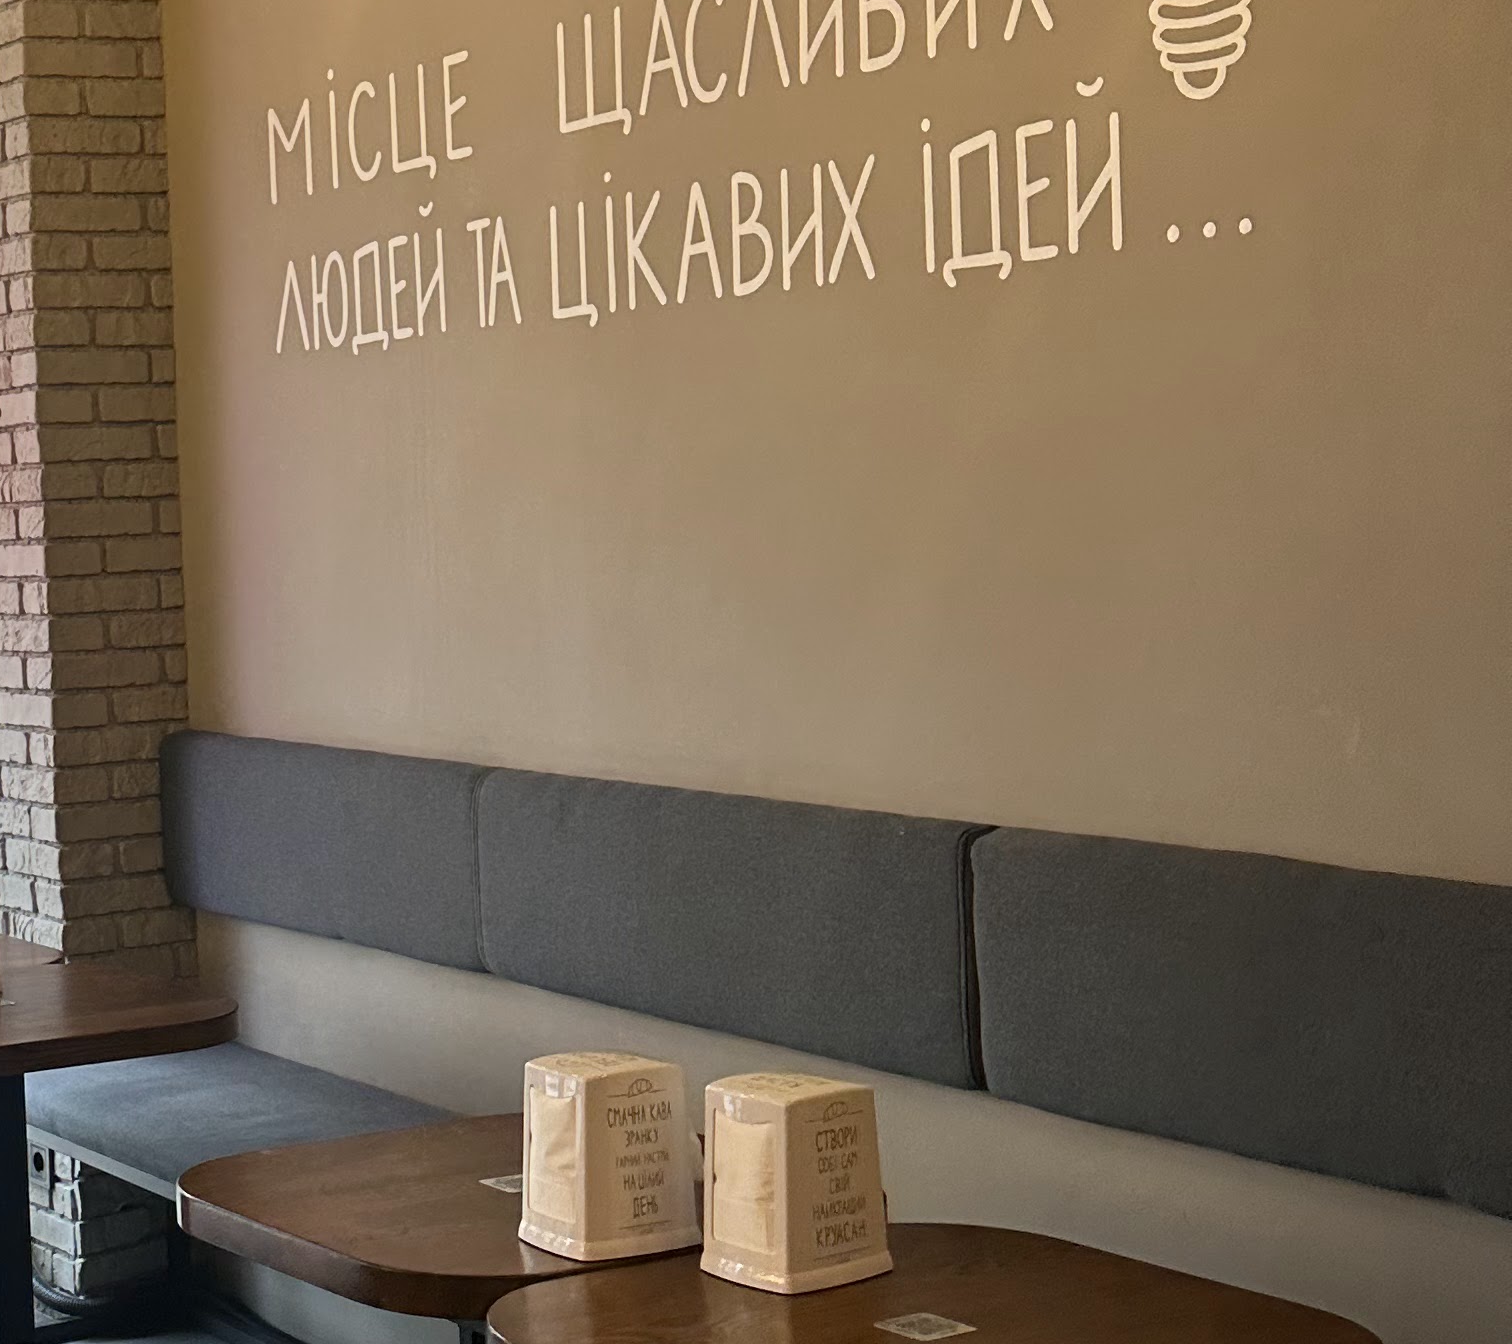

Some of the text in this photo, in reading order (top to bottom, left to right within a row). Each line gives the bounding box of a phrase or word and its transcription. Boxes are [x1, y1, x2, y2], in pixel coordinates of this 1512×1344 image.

[276, 200, 447, 355] ЛЮДЕЙ
[466, 214, 522, 329] ТА
[607, 1100, 672, 1128] СМАЧНА КАВА
[624, 1127, 659, 1148] ЗРАНКУ
[815, 1124, 858, 1153] СТВОРИ
[840, 1151, 858, 1169] САМ
[623, 1173, 637, 1190] НА
[633, 1194, 659, 1219] ДЕНЬ
[815, 1218, 867, 1248] КРУАСАН
